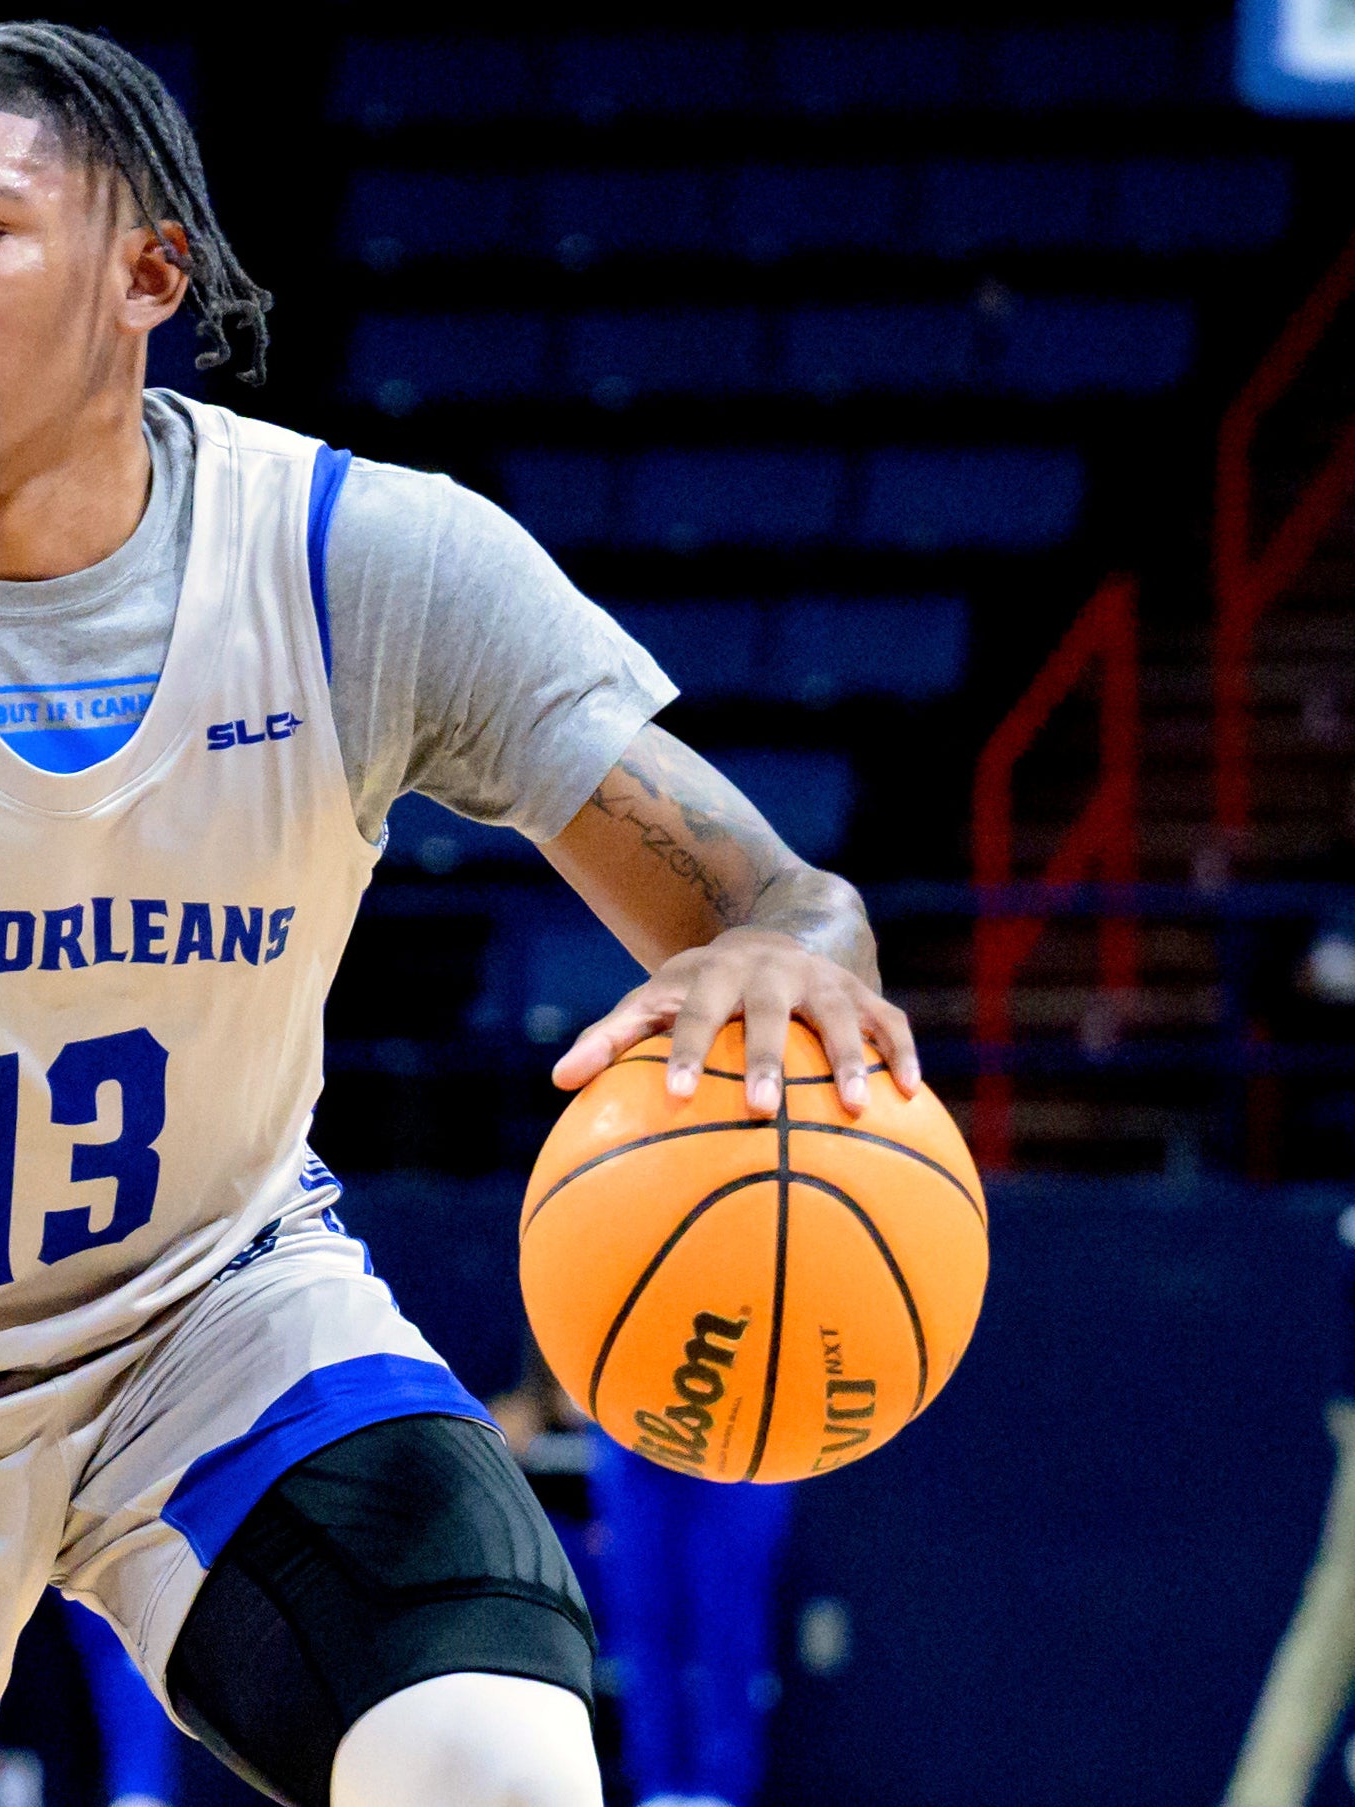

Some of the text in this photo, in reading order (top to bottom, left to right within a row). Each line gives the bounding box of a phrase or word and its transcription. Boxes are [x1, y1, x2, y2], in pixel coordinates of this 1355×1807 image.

[47, 701, 69, 722] IF
[76, 701, 84, 720] I
[206, 711, 300, 751] SLC
[818, 1324, 844, 1375] NXT
